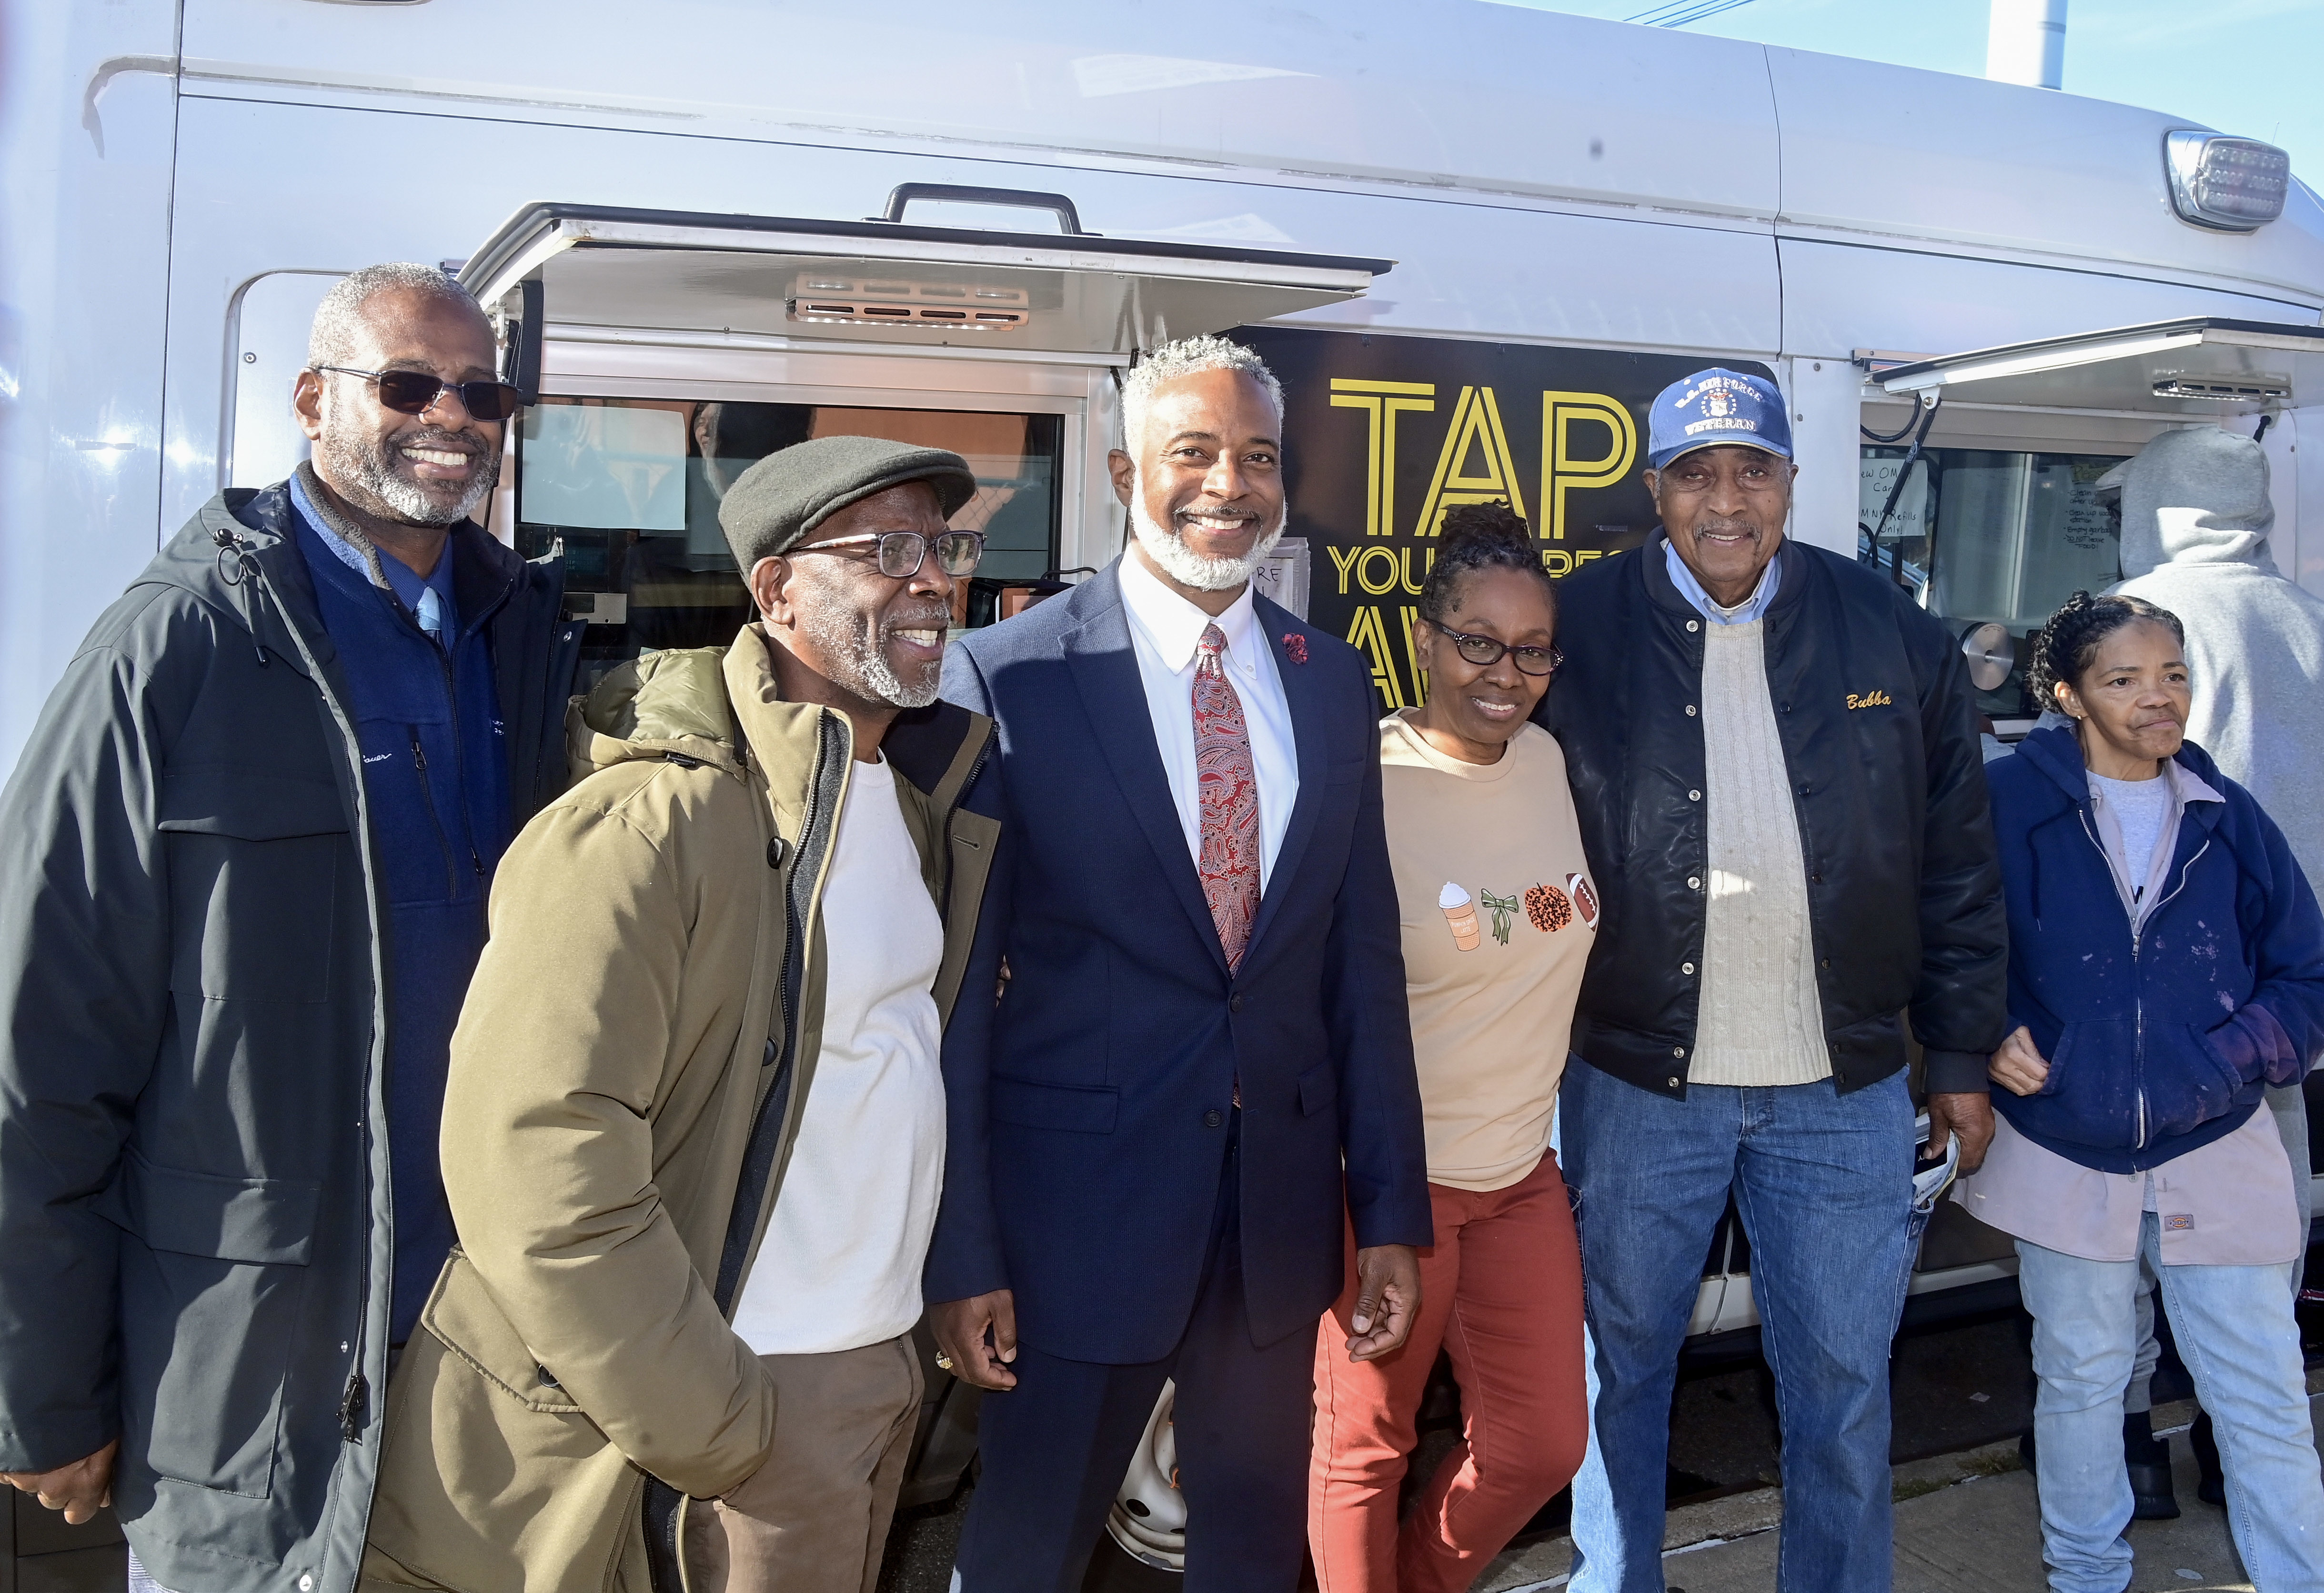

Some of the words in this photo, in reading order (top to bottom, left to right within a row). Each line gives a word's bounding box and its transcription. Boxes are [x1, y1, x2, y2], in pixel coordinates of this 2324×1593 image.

[1723, 377, 1764, 402] FORCE
[1684, 418, 1756, 436] VETERAN
[1330, 379, 1637, 539] TAP
[1861, 469, 1874, 478] ew
[1873, 482, 1892, 492] Car
[1861, 508, 1885, 520] MNY
[1890, 509, 1917, 521] Refills
[1880, 523, 1902, 534] Only!
[1257, 566, 1282, 581] RE
[1326, 546, 1435, 595] YOU
[1846, 690, 1892, 710] Bubba
[362, 753, 392, 763] auer
